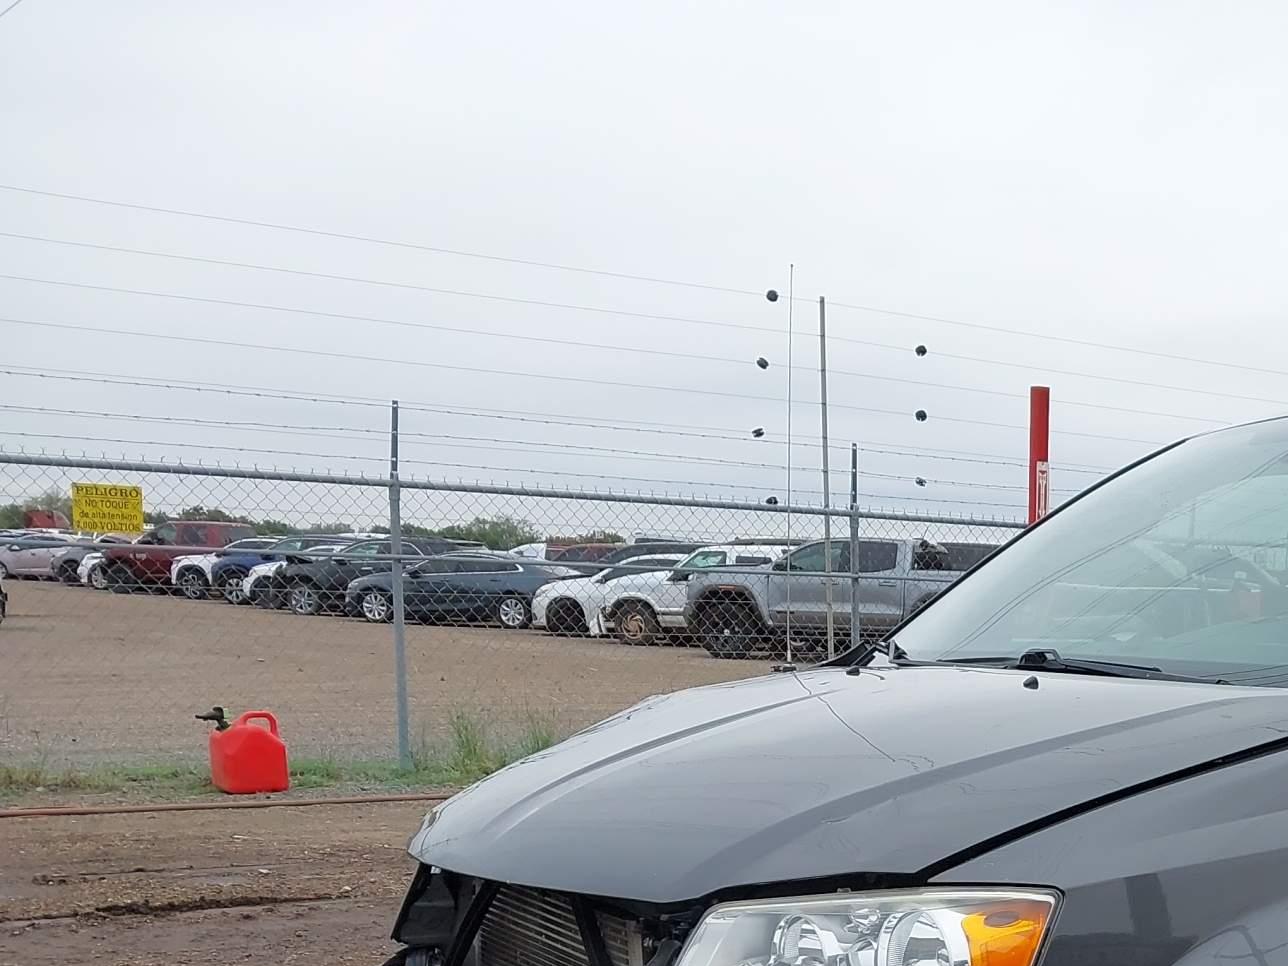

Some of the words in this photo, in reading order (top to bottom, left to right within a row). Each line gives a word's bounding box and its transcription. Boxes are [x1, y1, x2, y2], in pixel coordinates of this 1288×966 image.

[75, 485, 140, 498] PELIGRO
[85, 499, 97, 508] NO
[100, 499, 130, 510] TOQUE
[79, 510, 89, 519] de
[99, 521, 141, 533] VOLTIOS
